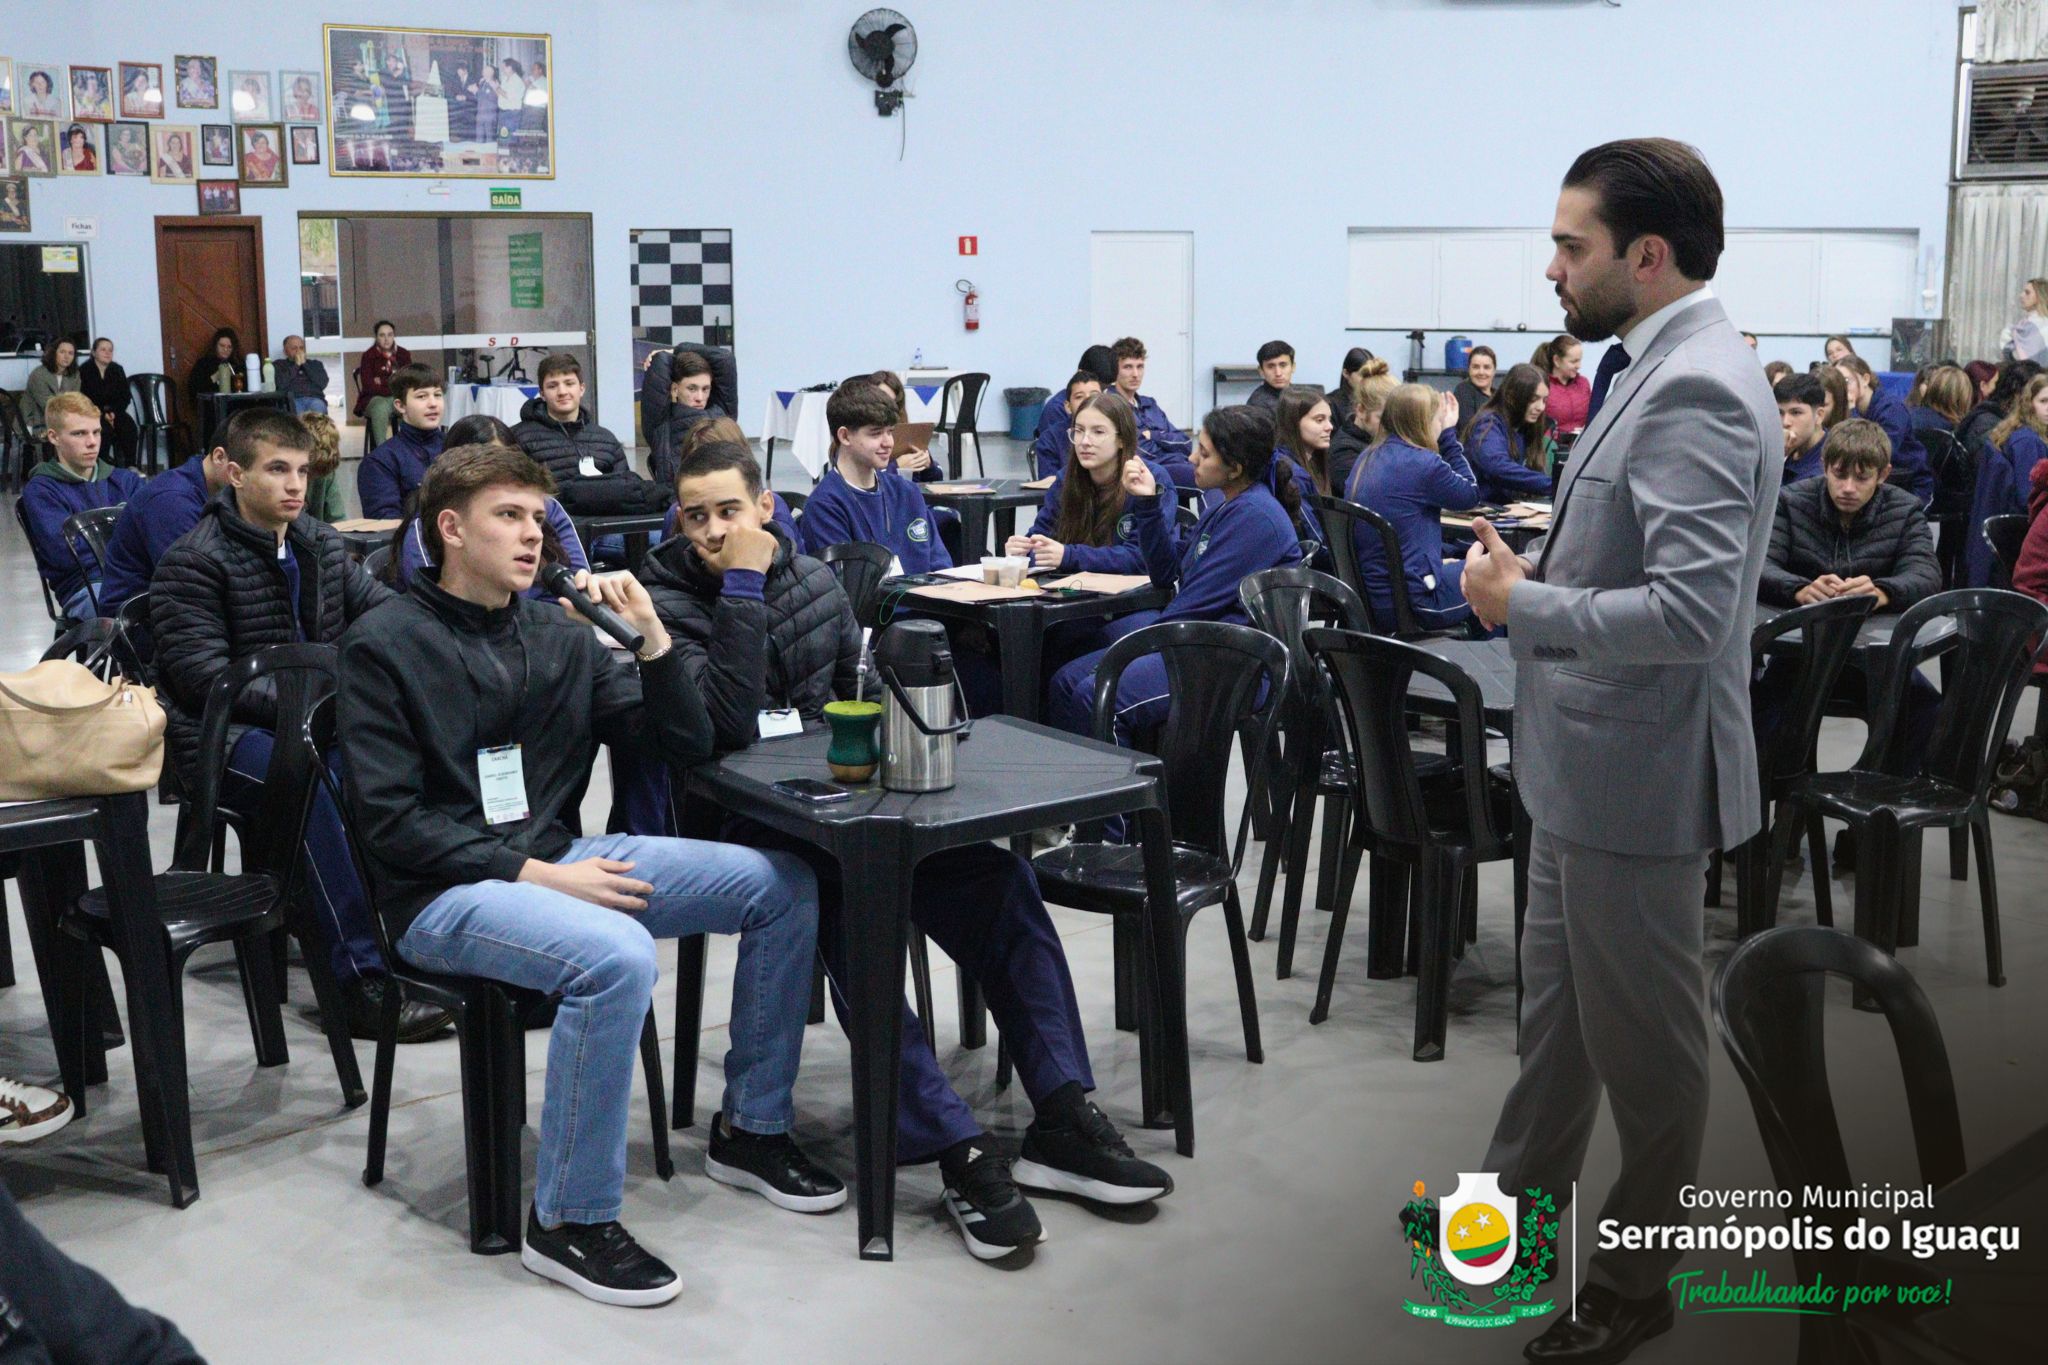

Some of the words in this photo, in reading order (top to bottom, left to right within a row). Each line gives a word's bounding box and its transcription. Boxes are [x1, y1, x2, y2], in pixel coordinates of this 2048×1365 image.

[492, 193, 520, 205] SAÍDA
[488, 337, 496, 347] S
[510, 336, 519, 346] D
